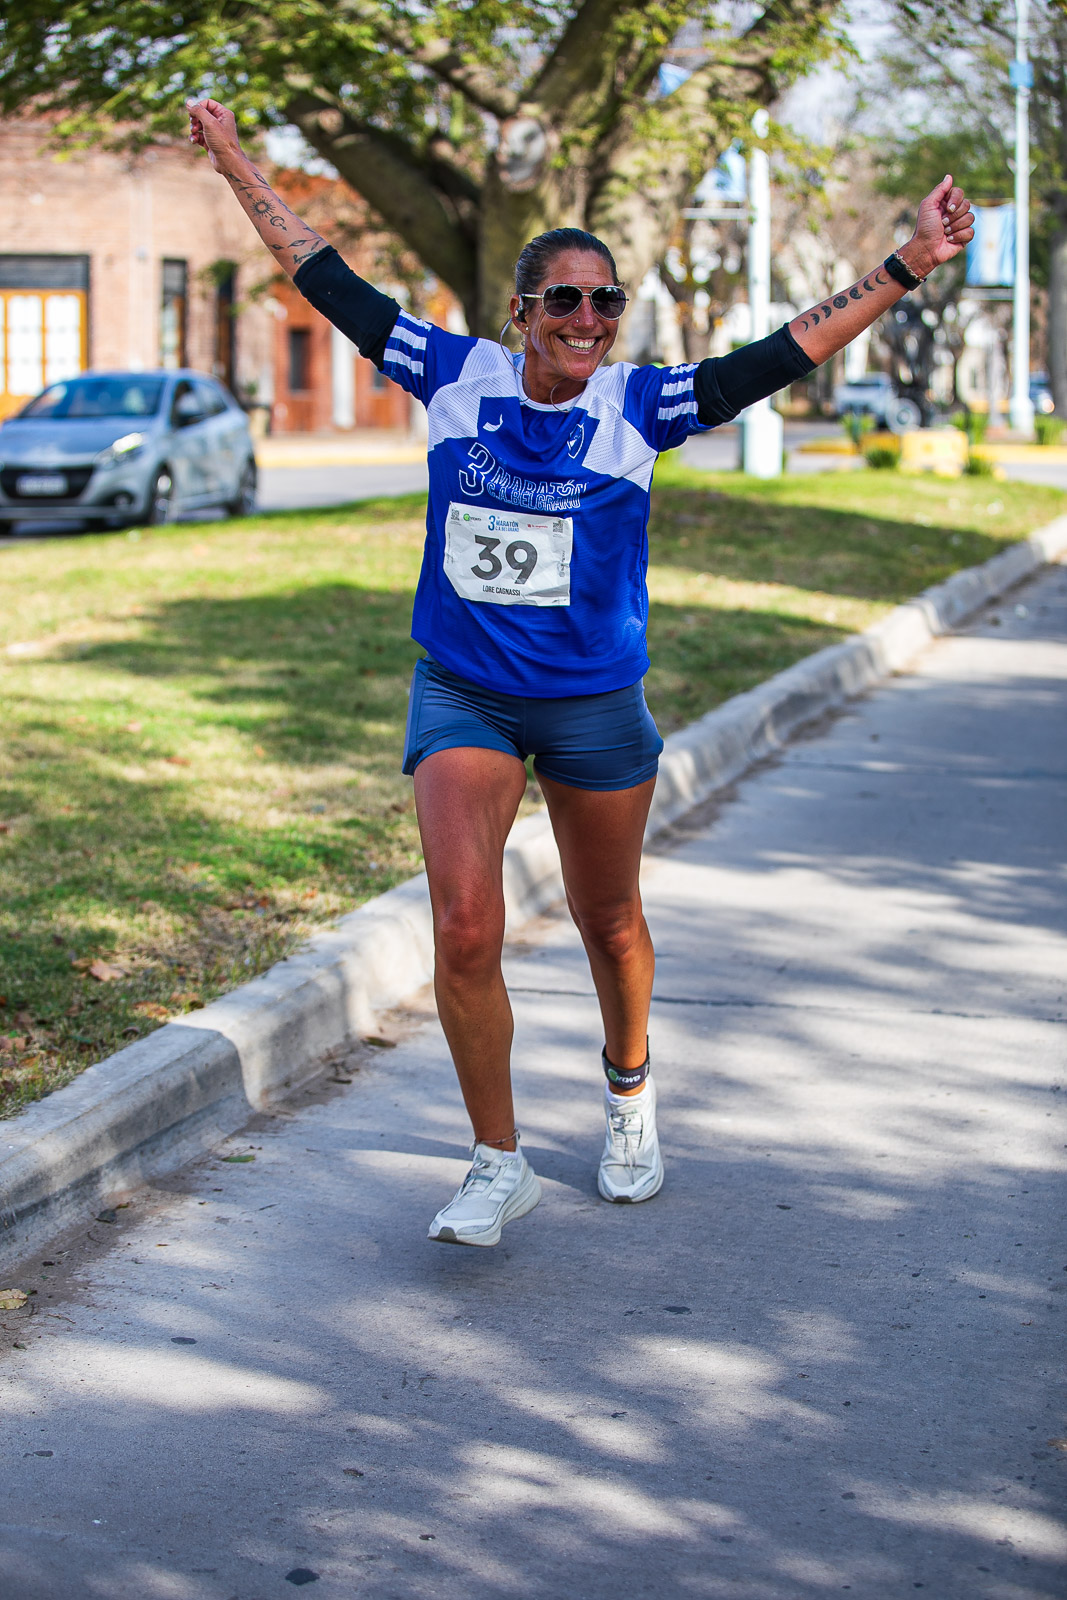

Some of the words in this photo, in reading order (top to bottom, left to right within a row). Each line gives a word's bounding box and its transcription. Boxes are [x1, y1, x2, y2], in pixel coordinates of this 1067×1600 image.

[458, 442, 496, 497] 3
[470, 534, 538, 585] 39
[482, 585, 495, 594] LORE
[495, 587, 521, 597] CAGNASSI
